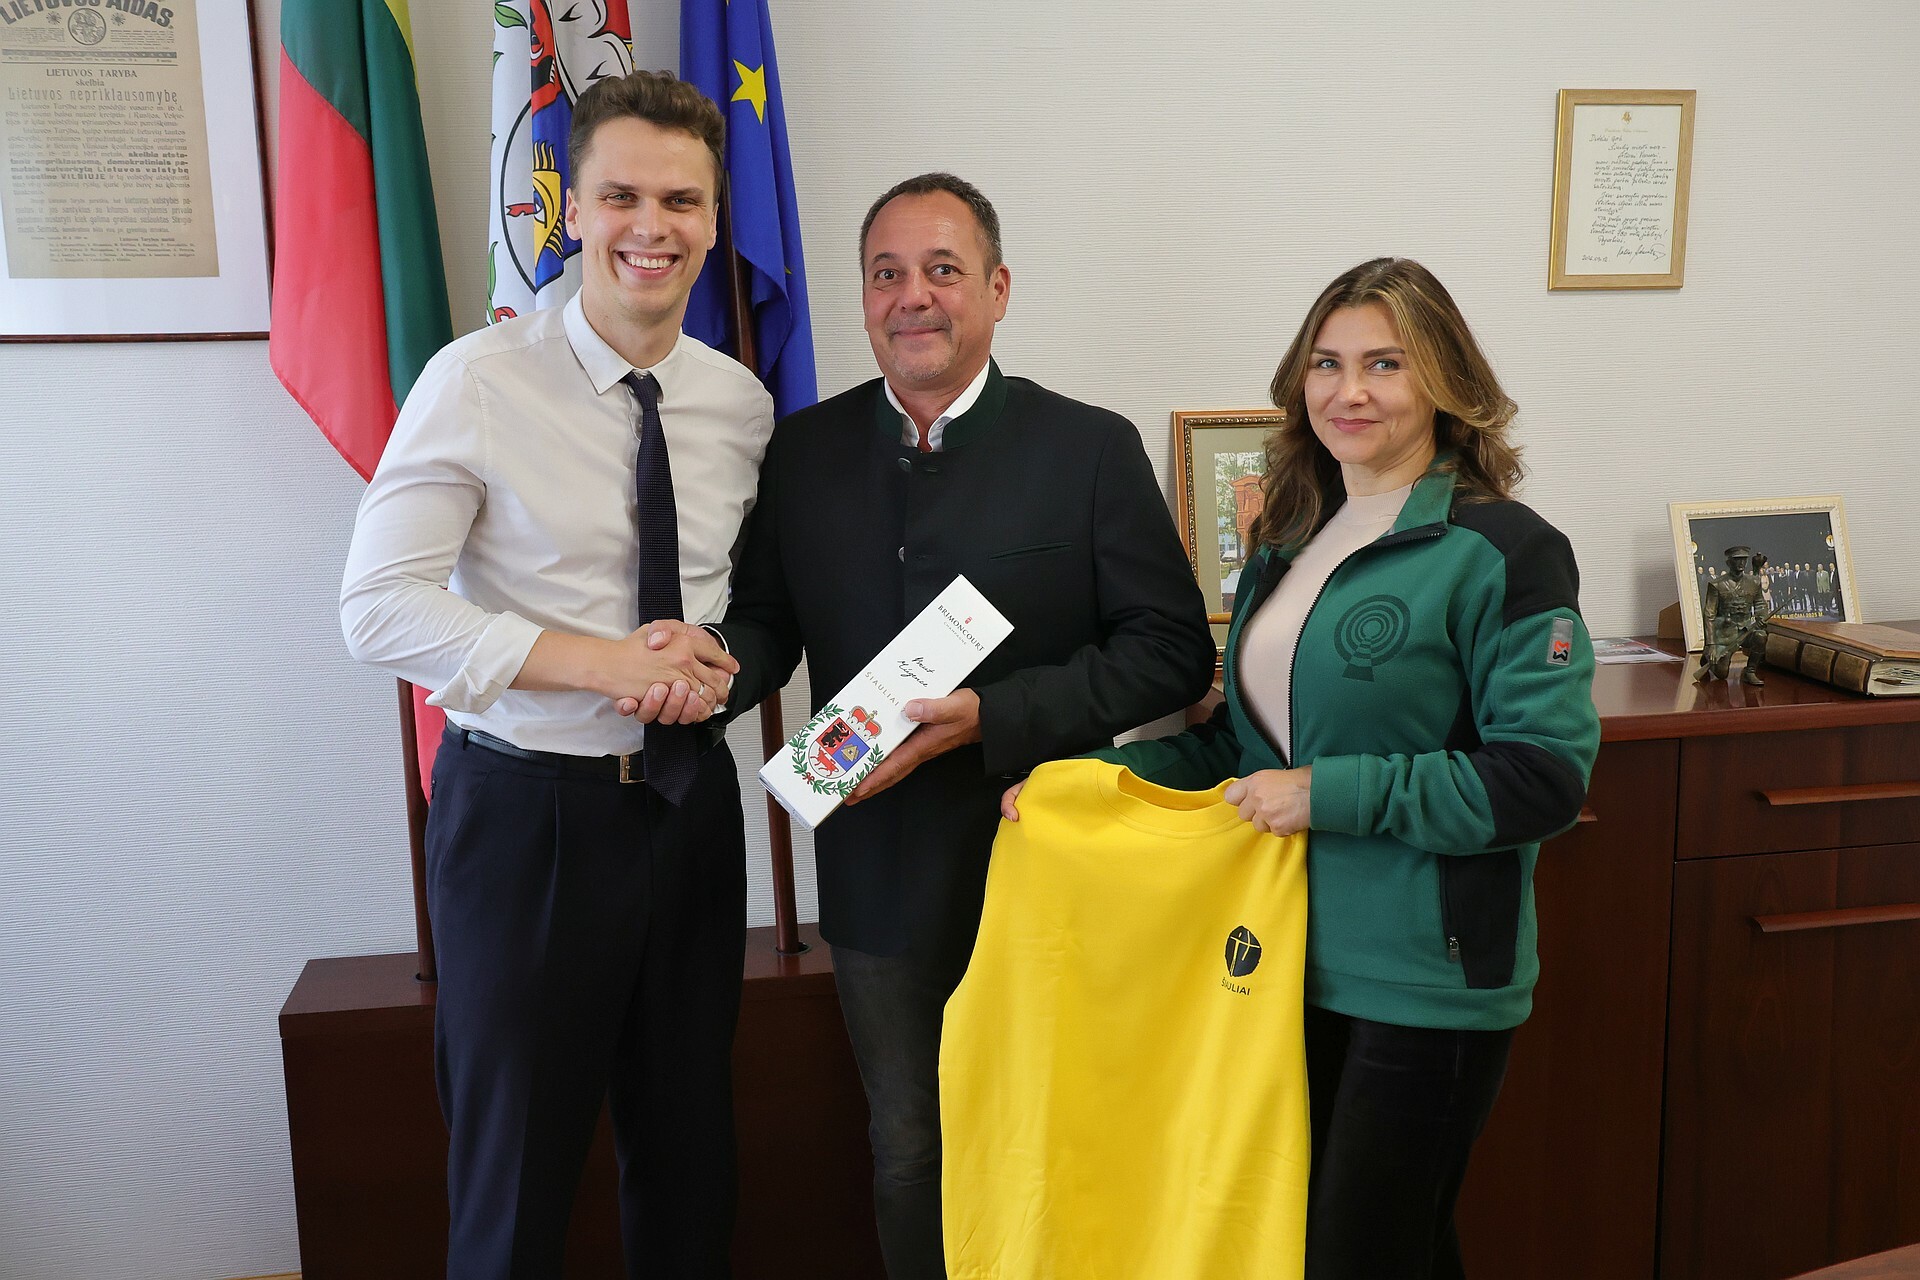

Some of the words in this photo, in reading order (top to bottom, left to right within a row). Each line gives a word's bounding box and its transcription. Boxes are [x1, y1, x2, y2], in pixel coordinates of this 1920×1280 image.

[46, 68, 93, 77] LIETUVOS
[100, 70, 138, 78] TARYBA
[8, 87, 62, 100] Lietuvos
[70, 88, 178, 105] nepriklausomybę
[937, 604, 986, 652] BRIMONCOURT
